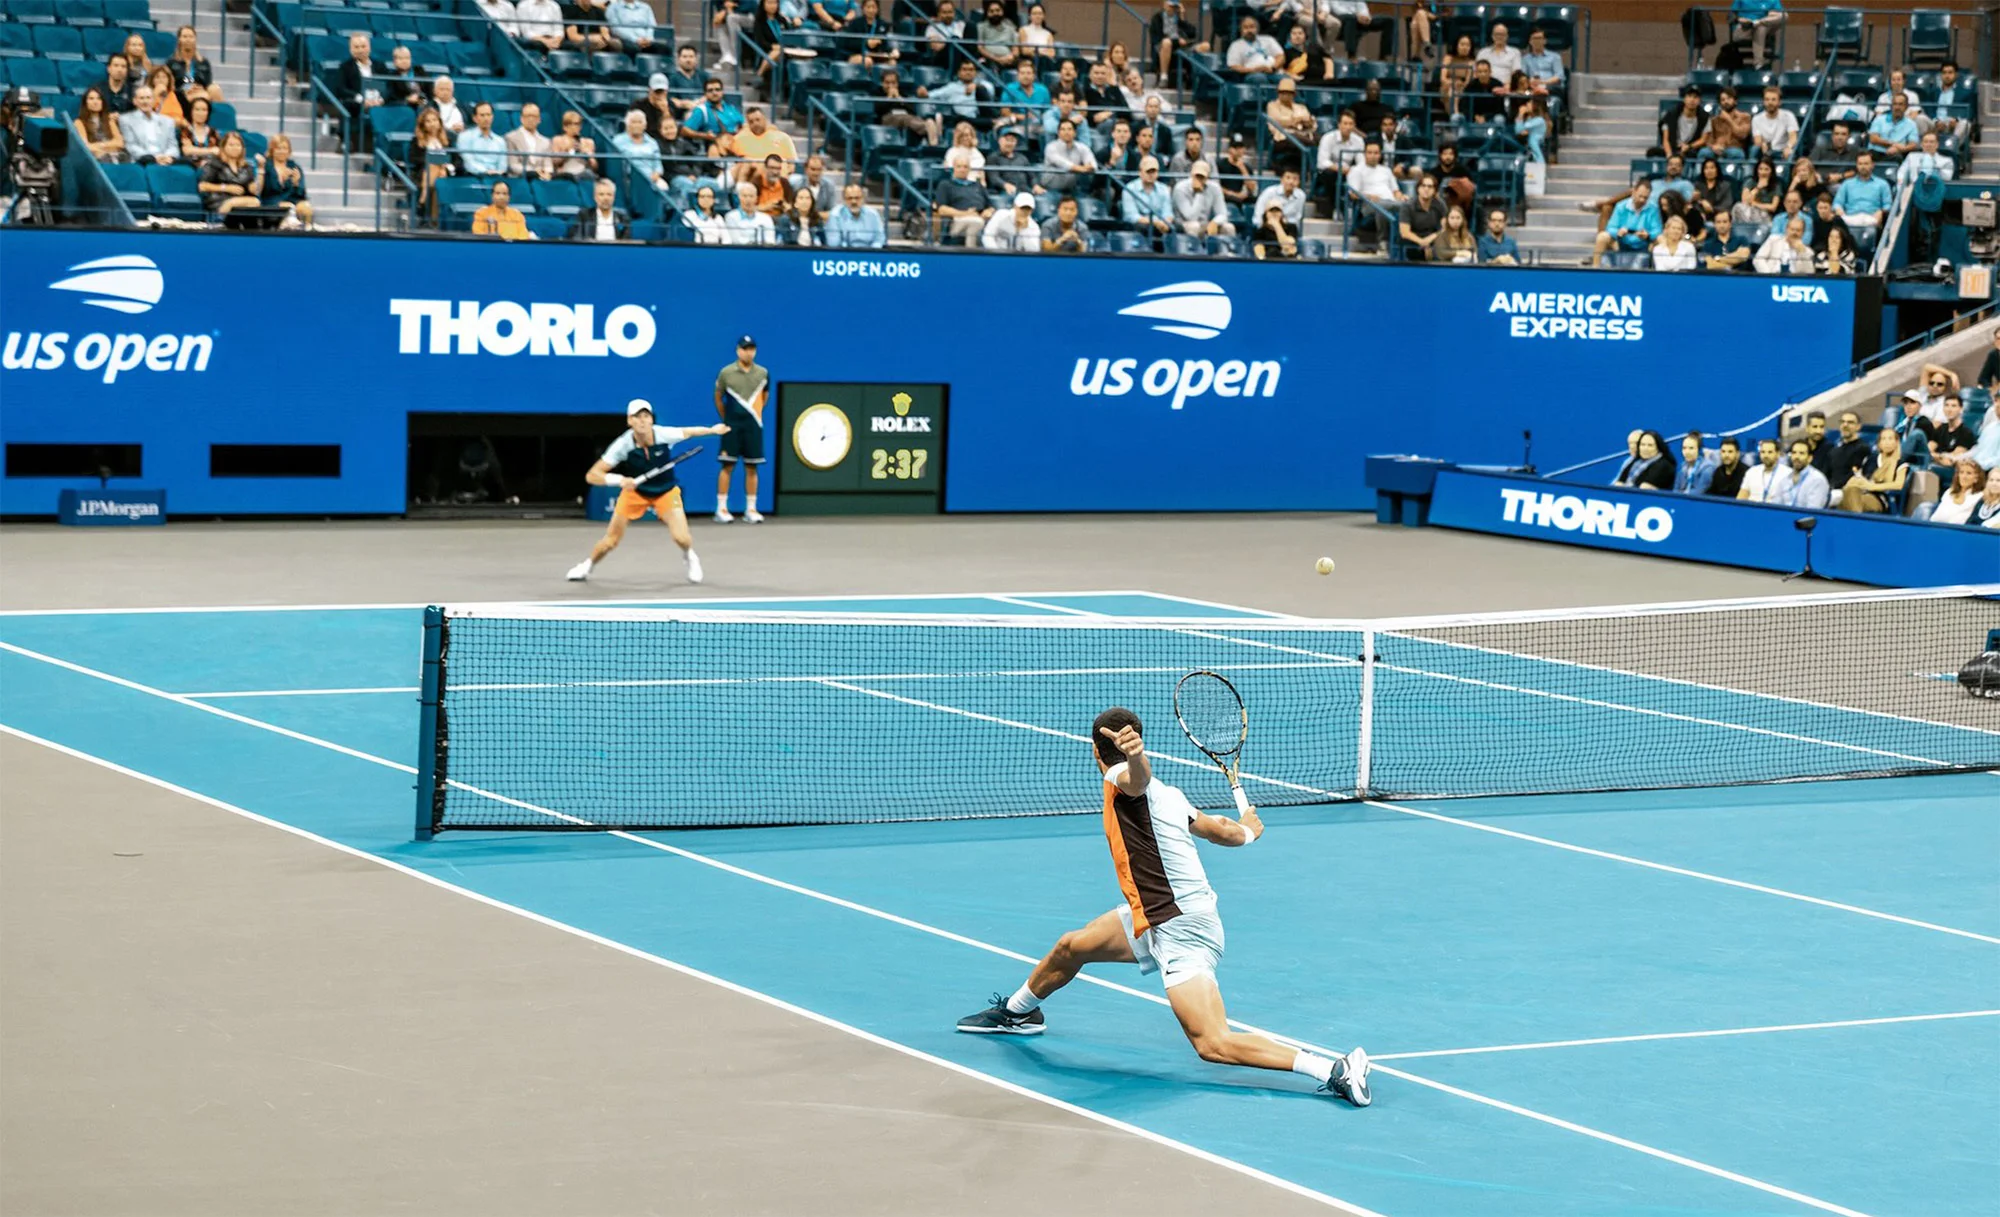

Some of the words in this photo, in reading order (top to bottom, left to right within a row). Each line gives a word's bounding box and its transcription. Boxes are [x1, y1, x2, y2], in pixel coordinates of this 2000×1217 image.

[812, 260, 921, 278] USOPEN.ORG
[1489, 291, 1643, 317] AMERICAN
[1771, 285, 1830, 303] USTA
[389, 298, 657, 358] THORLO
[1510, 316, 1644, 341] EXPRESS
[2, 332, 69, 370] us
[73, 333, 213, 384] open
[1070, 358, 1138, 396] us
[1142, 359, 1281, 410] open
[871, 416, 931, 433] ROLEX
[871, 449, 928, 480] 2:37
[1500, 488, 1674, 543] THORLO
